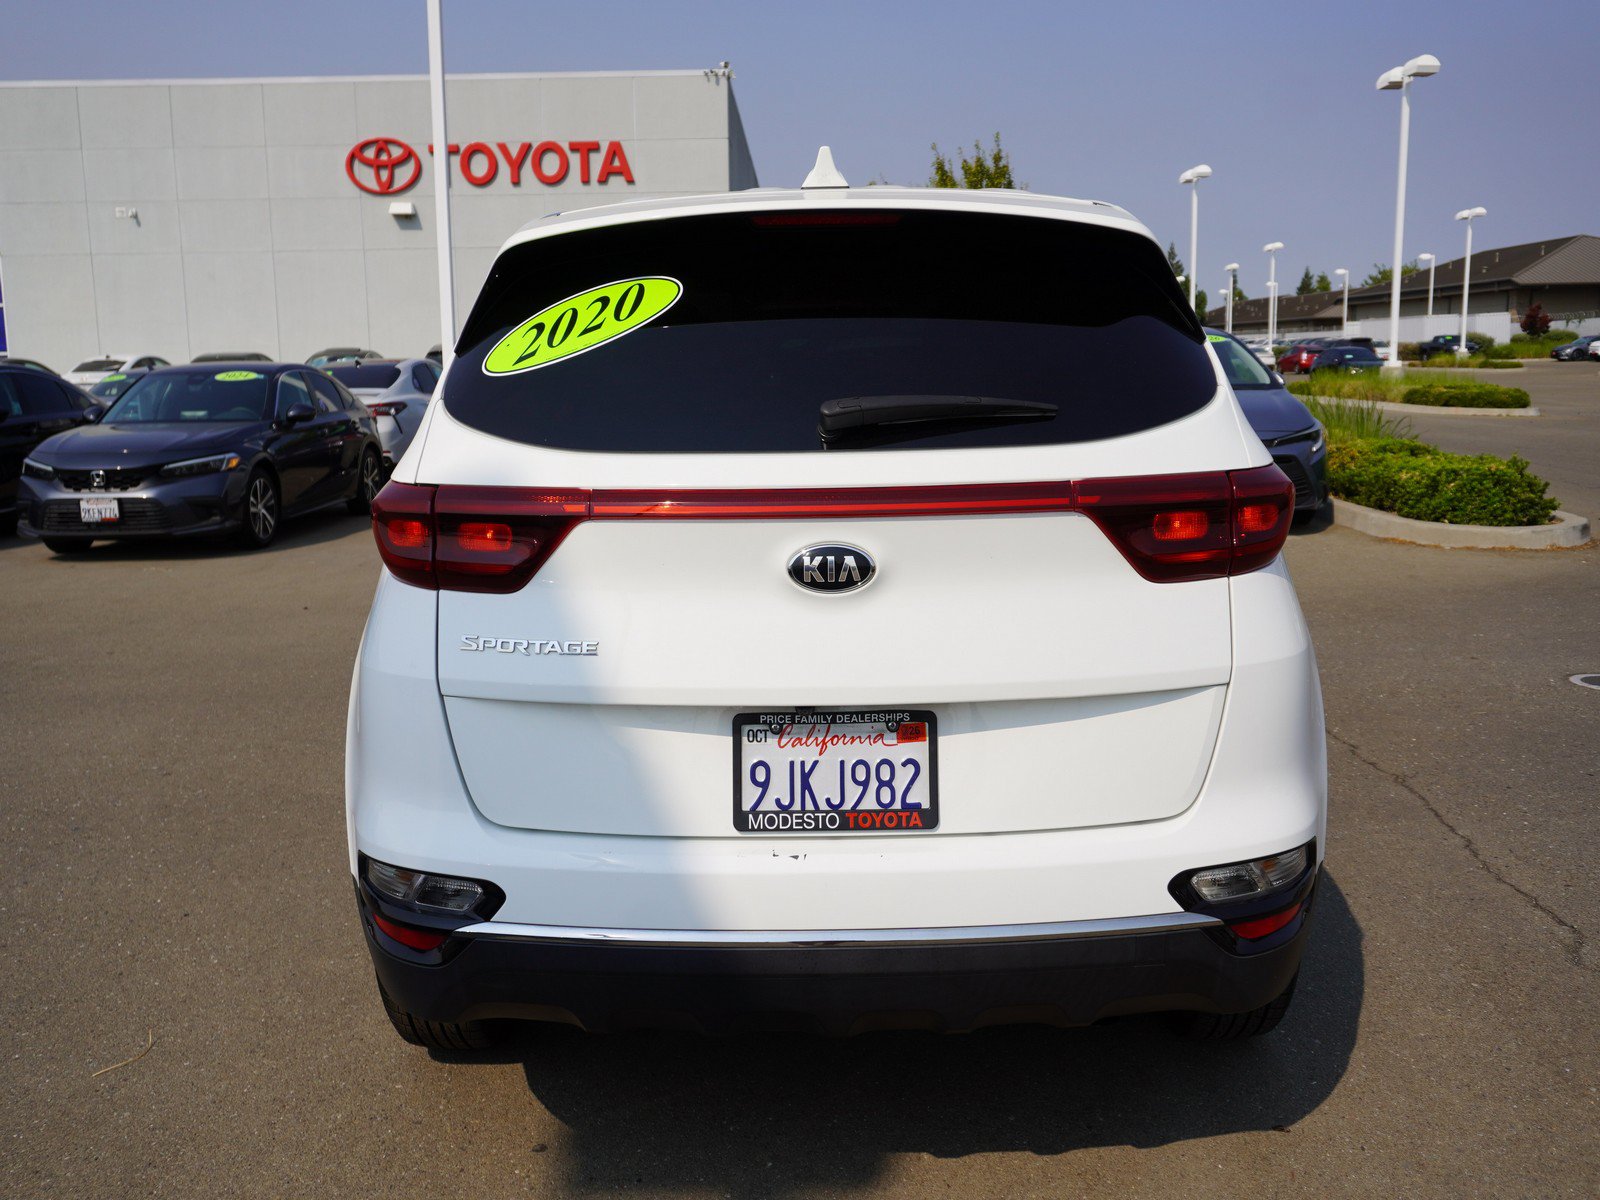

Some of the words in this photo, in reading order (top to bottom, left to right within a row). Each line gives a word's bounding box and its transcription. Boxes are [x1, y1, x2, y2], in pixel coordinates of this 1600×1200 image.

[512, 283, 646, 367] 2020
[802, 555, 861, 583] KIA
[460, 635, 599, 656] SPORTAGE
[760, 714, 792, 724] PRICE
[795, 714, 833, 724] FAMILY
[836, 712, 910, 723] DEALERSHIPS
[747, 728, 770, 743] OCT
[777, 723, 898, 756] California
[749, 757, 922, 811] 9JKJ982
[748, 813, 840, 830] MODESTO
[845, 811, 923, 828] TOYOTA
